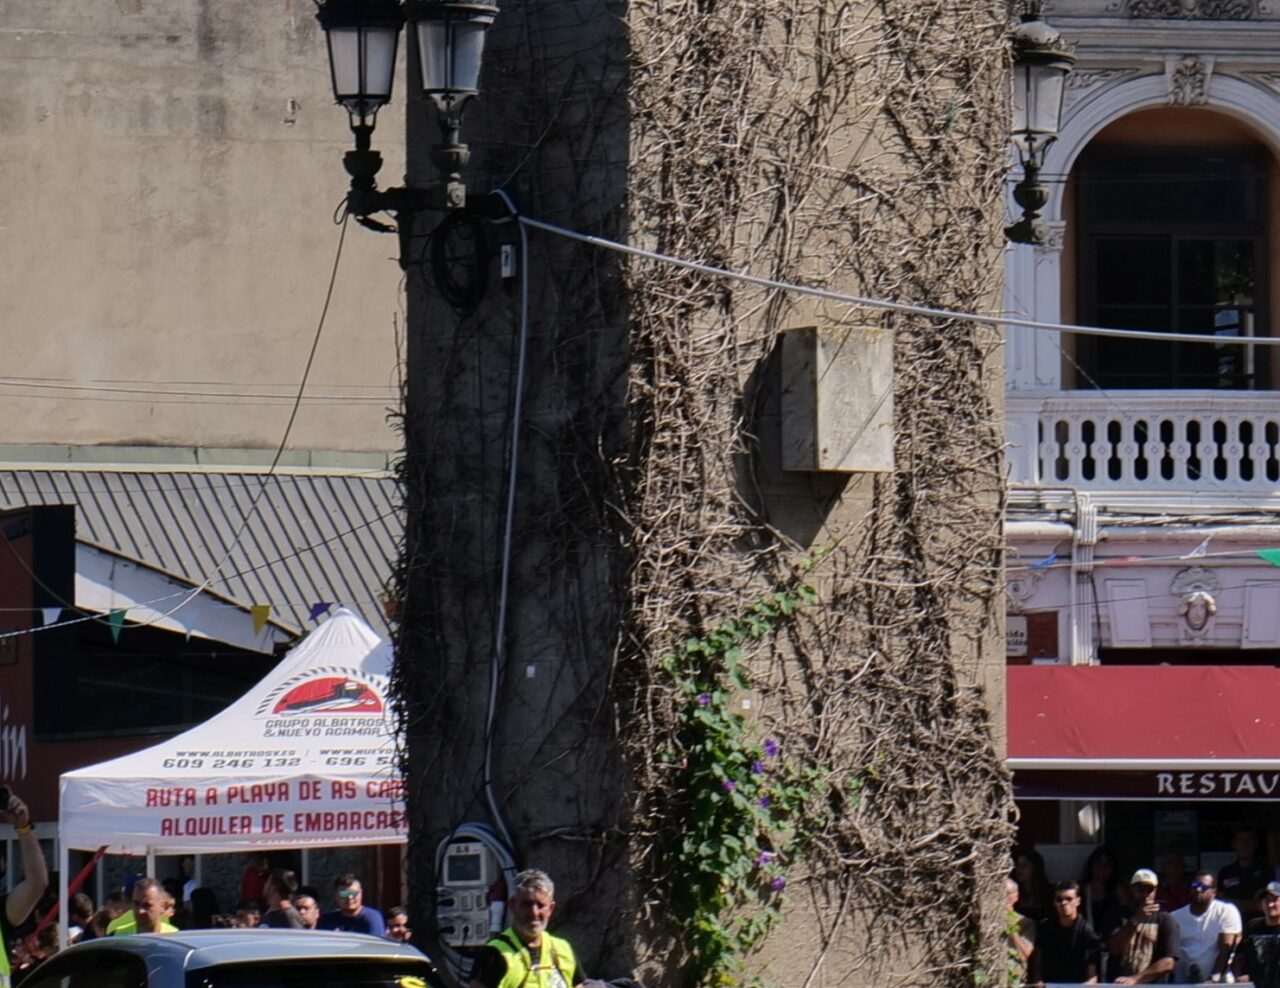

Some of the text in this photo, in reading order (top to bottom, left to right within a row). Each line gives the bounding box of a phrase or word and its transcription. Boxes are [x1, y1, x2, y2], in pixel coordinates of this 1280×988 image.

[266, 717, 384, 728] GRUPO ALBATROS
[276, 728, 322, 738] NUEVO
[325, 727, 381, 737] ACAMAR
[163, 758, 204, 768] 609
[212, 758, 253, 768] 246
[262, 758, 302, 768] 132
[326, 757, 366, 767] 696
[146, 788, 196, 807] RUTA
[205, 786, 218, 805] A
[227, 782, 289, 804] PLAYA
[299, 780, 322, 801] DE
[331, 780, 357, 799] AS
[161, 815, 252, 836] ALQUILER
[261, 814, 285, 833] DE
